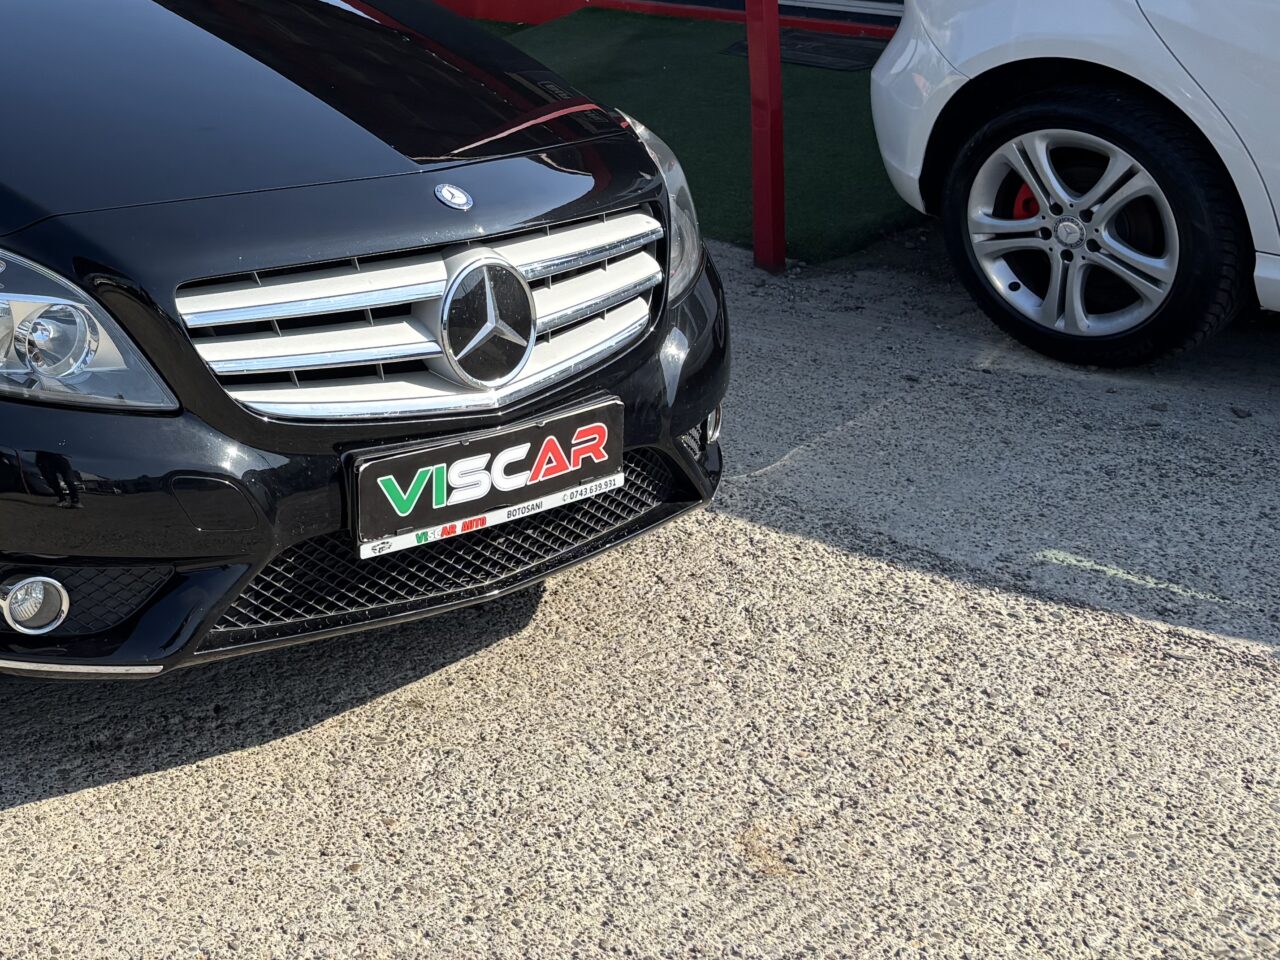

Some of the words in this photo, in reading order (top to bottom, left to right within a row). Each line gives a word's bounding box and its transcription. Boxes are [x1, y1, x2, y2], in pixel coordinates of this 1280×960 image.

[377, 422, 609, 517] VISCAR
[415, 523, 457, 545] VISCAR
[460, 516, 487, 533] AUTO
[506, 501, 543, 520] BOTOSANI
[569, 478, 617, 501] 0743.639.931
